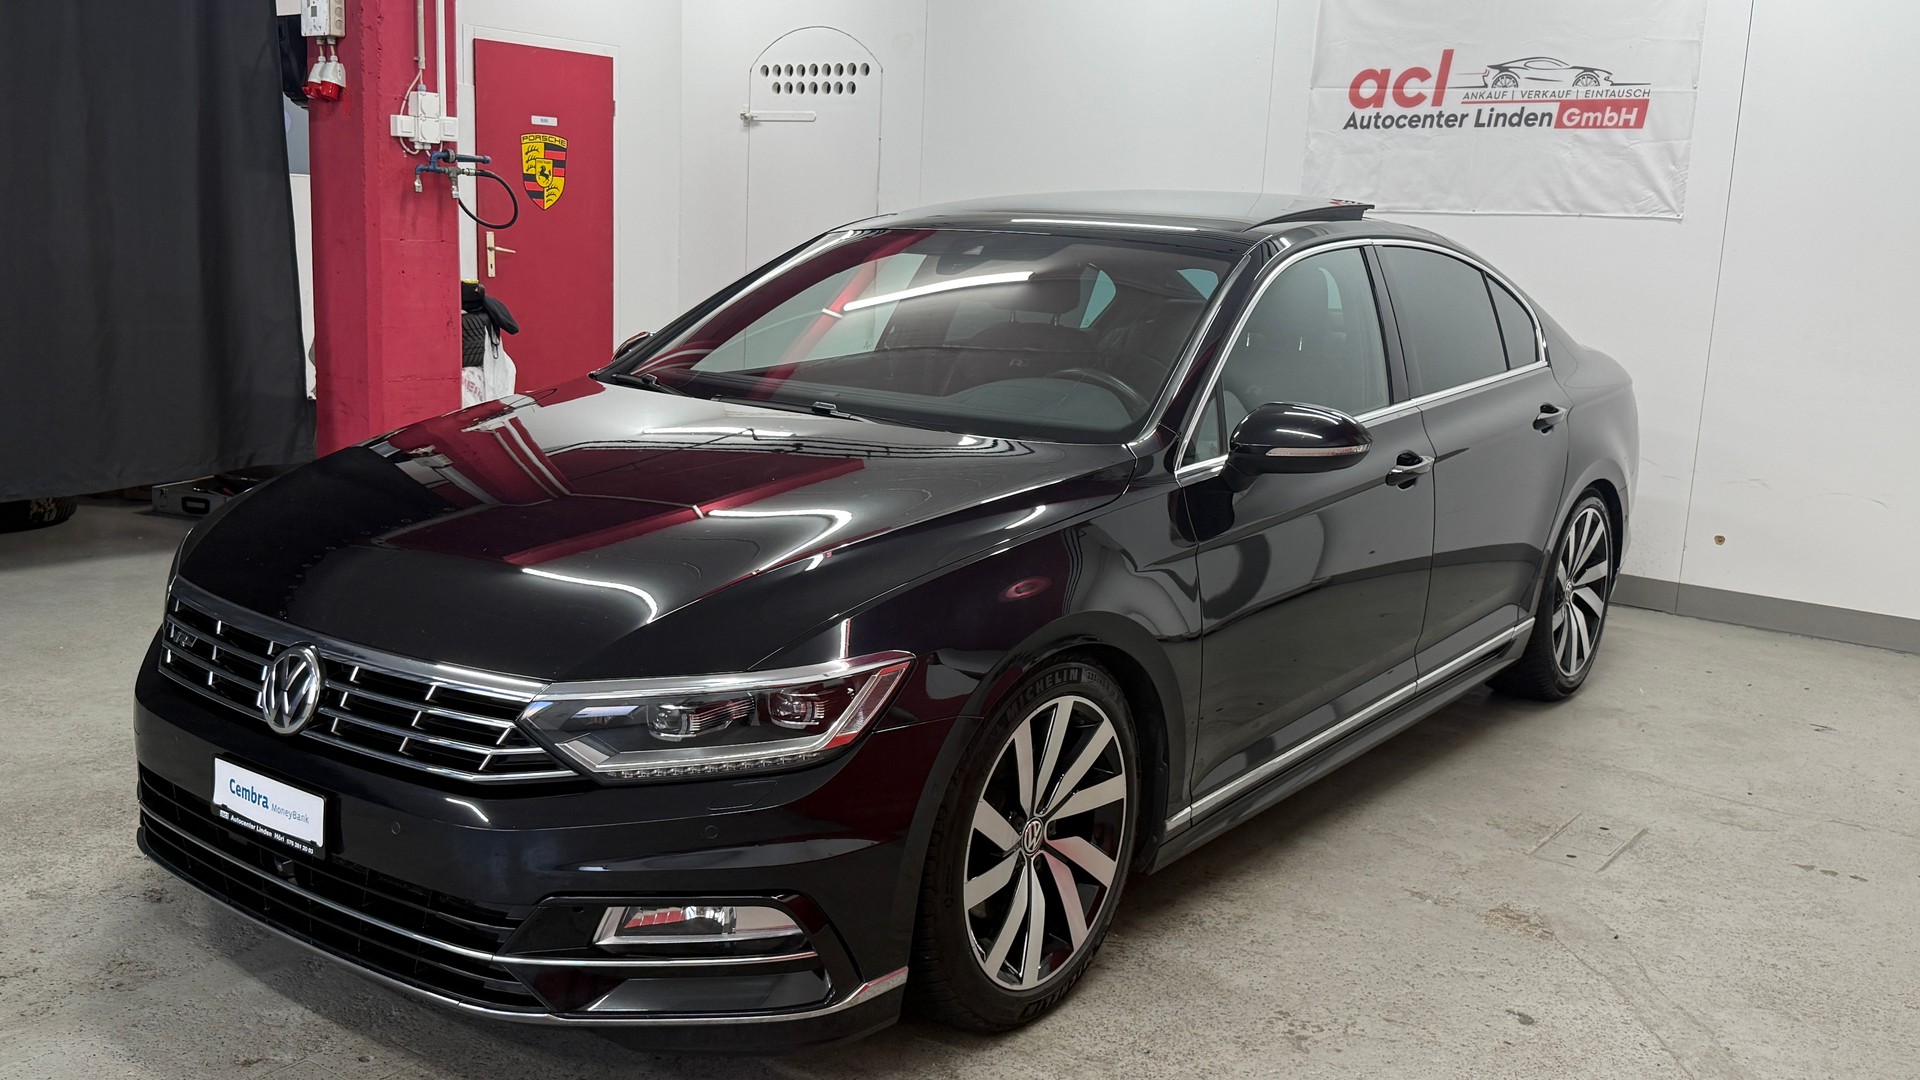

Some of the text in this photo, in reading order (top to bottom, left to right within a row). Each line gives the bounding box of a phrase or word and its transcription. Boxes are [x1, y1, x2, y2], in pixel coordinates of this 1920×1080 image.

[1348, 49, 1454, 110] acl
[1463, 89, 1508, 101] ANKAUF
[1520, 89, 1572, 100] VERKAUF
[1584, 88, 1651, 99] EINTAUSCH
[1342, 106, 1638, 130] Autocenter Linden GmbH
[522, 134, 566, 146] PORSCHE
[1005, 668, 1080, 722] MICHELIN
[229, 778, 269, 810] Cembra
[271, 803, 310, 824] MoneyBank
[231, 814, 256, 830] Autocenter
[256, 825, 273, 838] Linden
